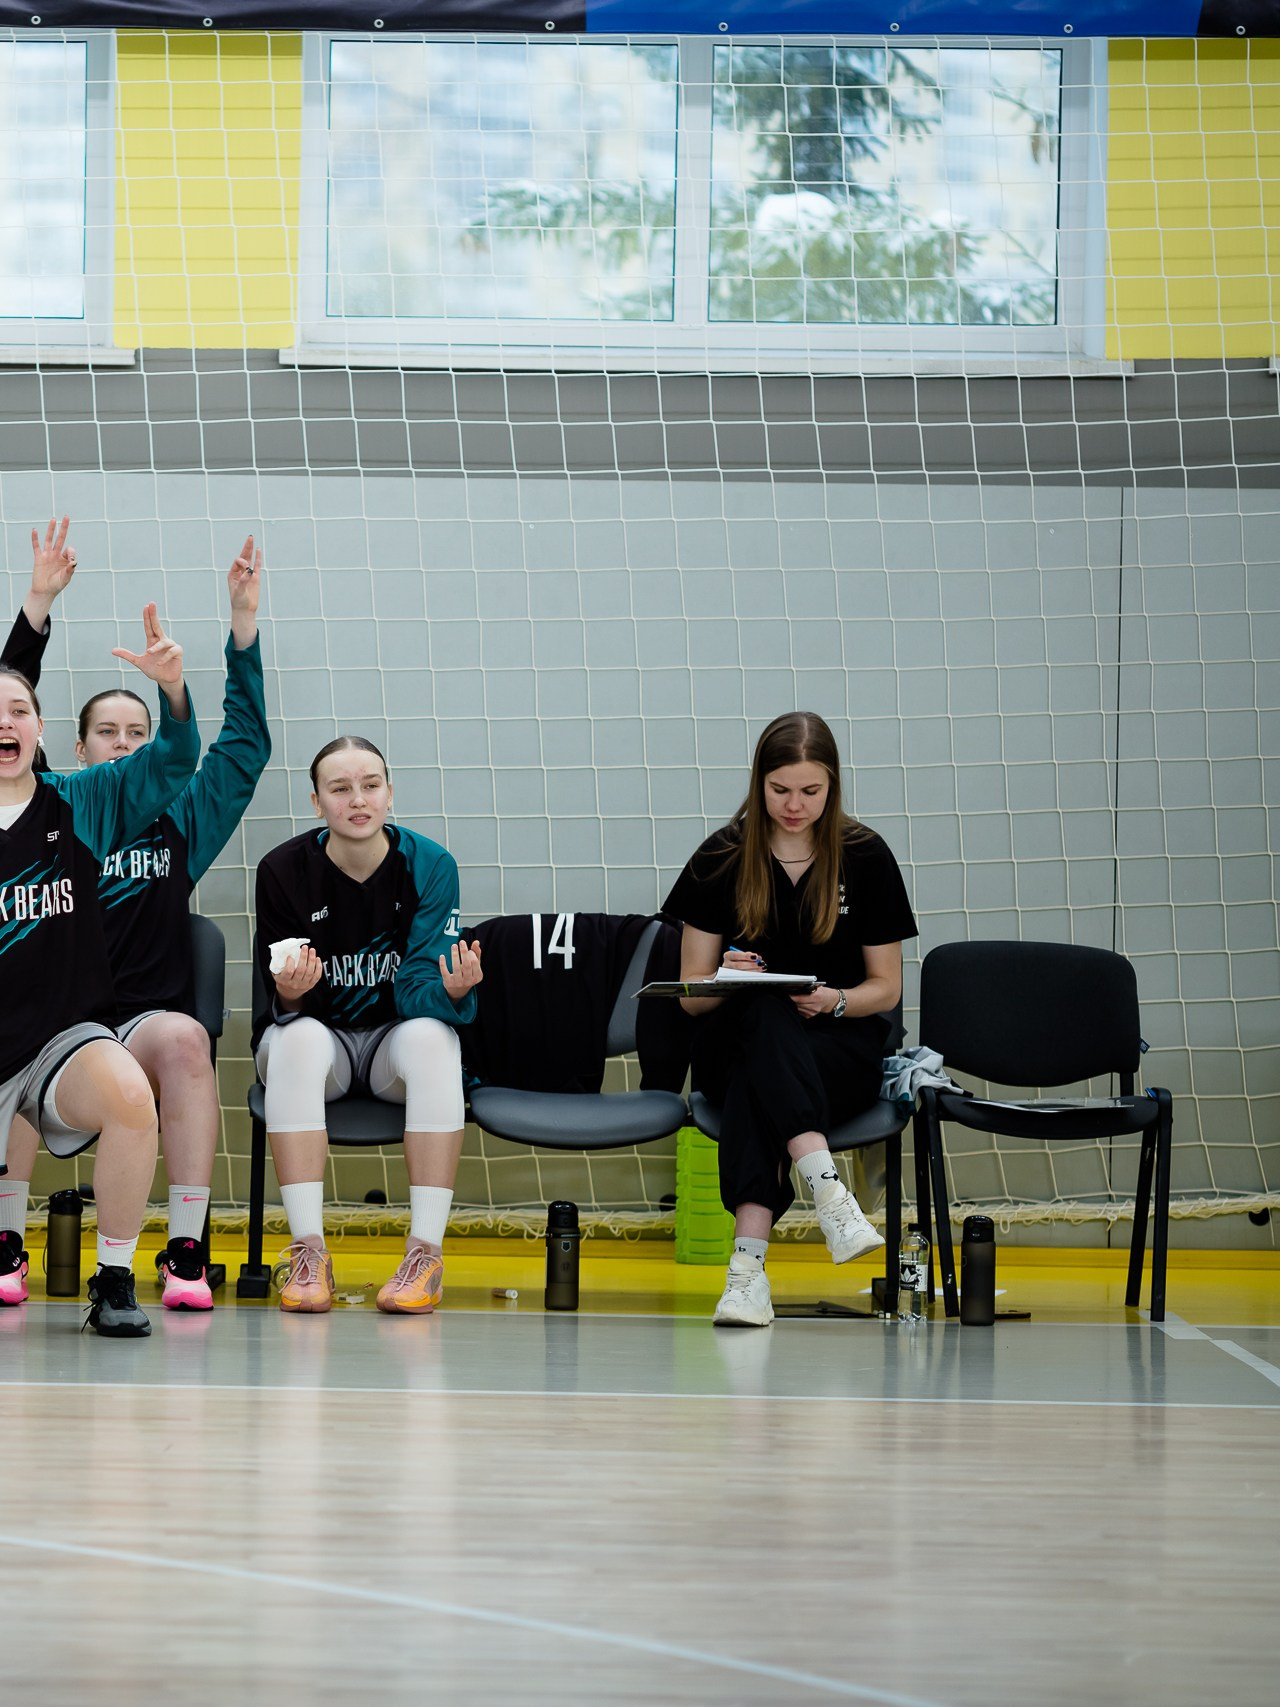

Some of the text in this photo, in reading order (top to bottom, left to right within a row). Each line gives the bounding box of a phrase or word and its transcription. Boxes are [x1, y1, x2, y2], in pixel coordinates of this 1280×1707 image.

[47, 830, 60, 842] ST
[14, 878, 74, 922] BEARS
[532, 913, 576, 970] 14
